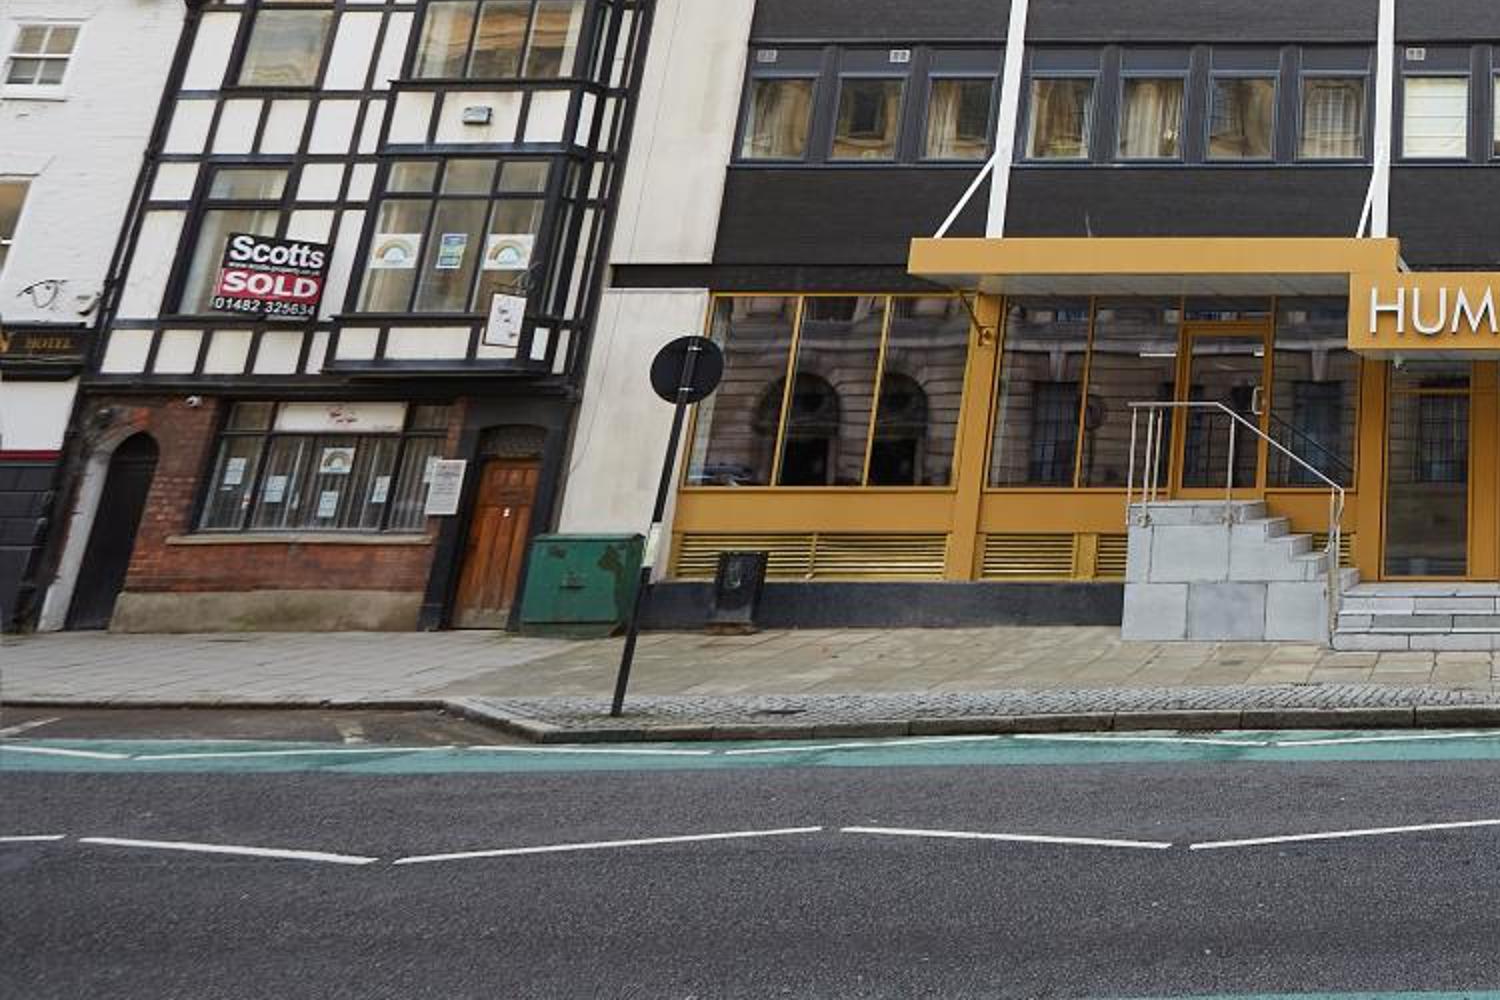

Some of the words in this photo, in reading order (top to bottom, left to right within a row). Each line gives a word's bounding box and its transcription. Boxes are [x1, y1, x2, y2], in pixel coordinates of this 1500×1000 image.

[229, 235, 325, 269] Scotts
[222, 271, 318, 298] SOLD
[215, 297, 260, 312] 01482
